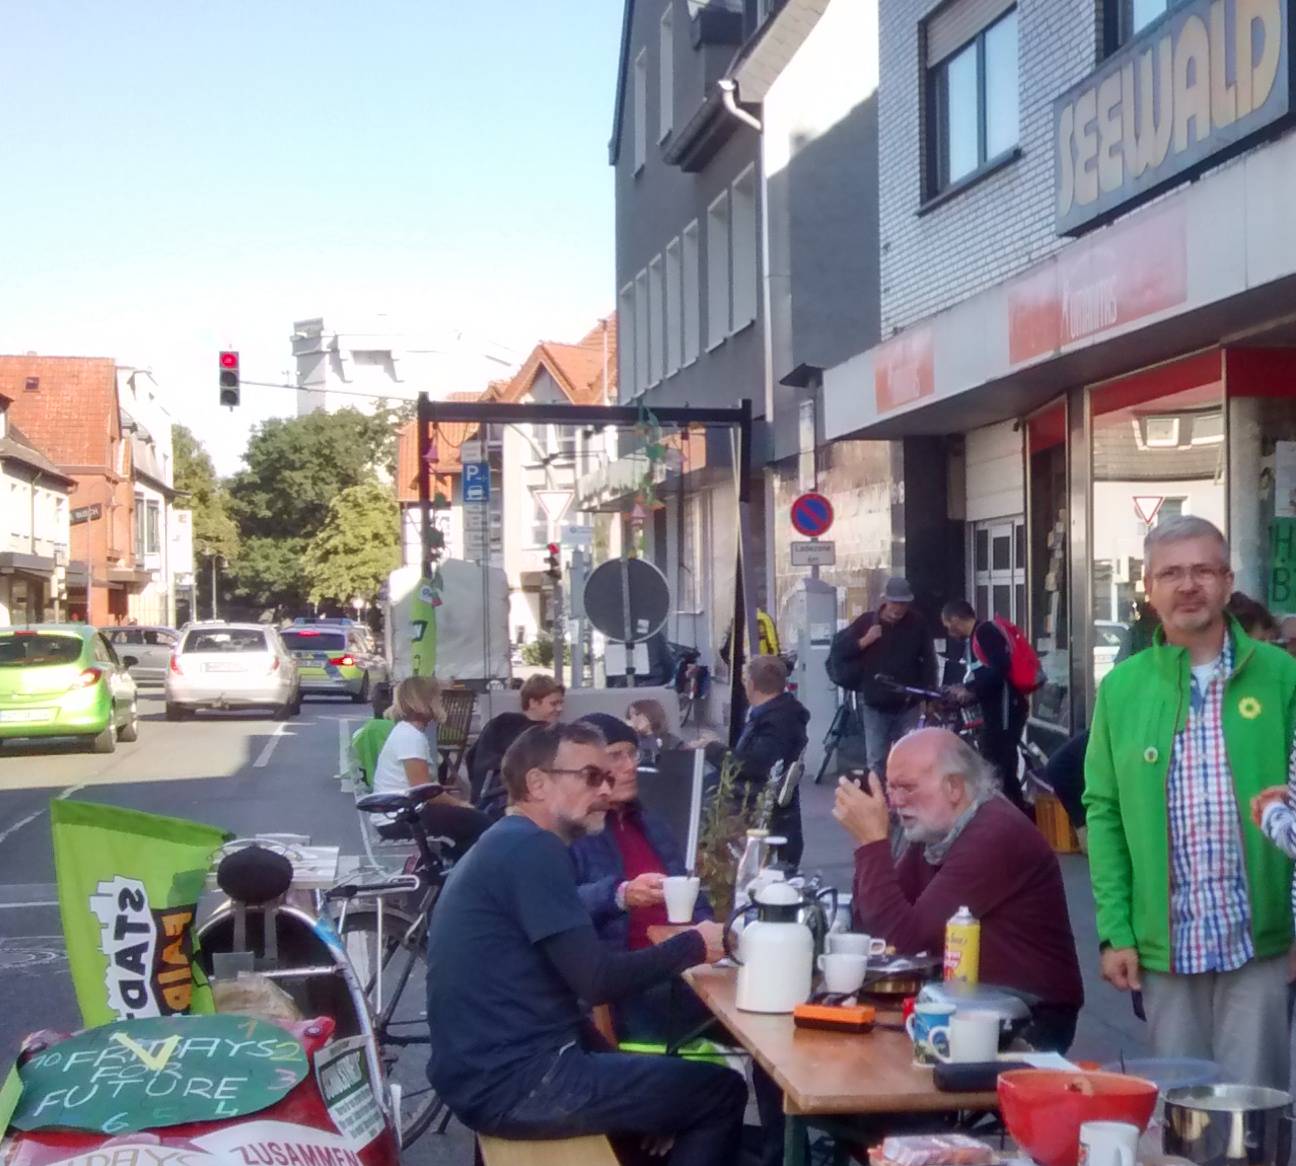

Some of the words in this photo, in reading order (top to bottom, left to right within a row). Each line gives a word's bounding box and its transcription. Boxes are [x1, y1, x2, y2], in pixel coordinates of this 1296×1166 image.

[1059, 0, 1281, 217] SEEWALD
[466, 465, 479, 481] P
[33, 1077, 248, 1116] FUTURE
